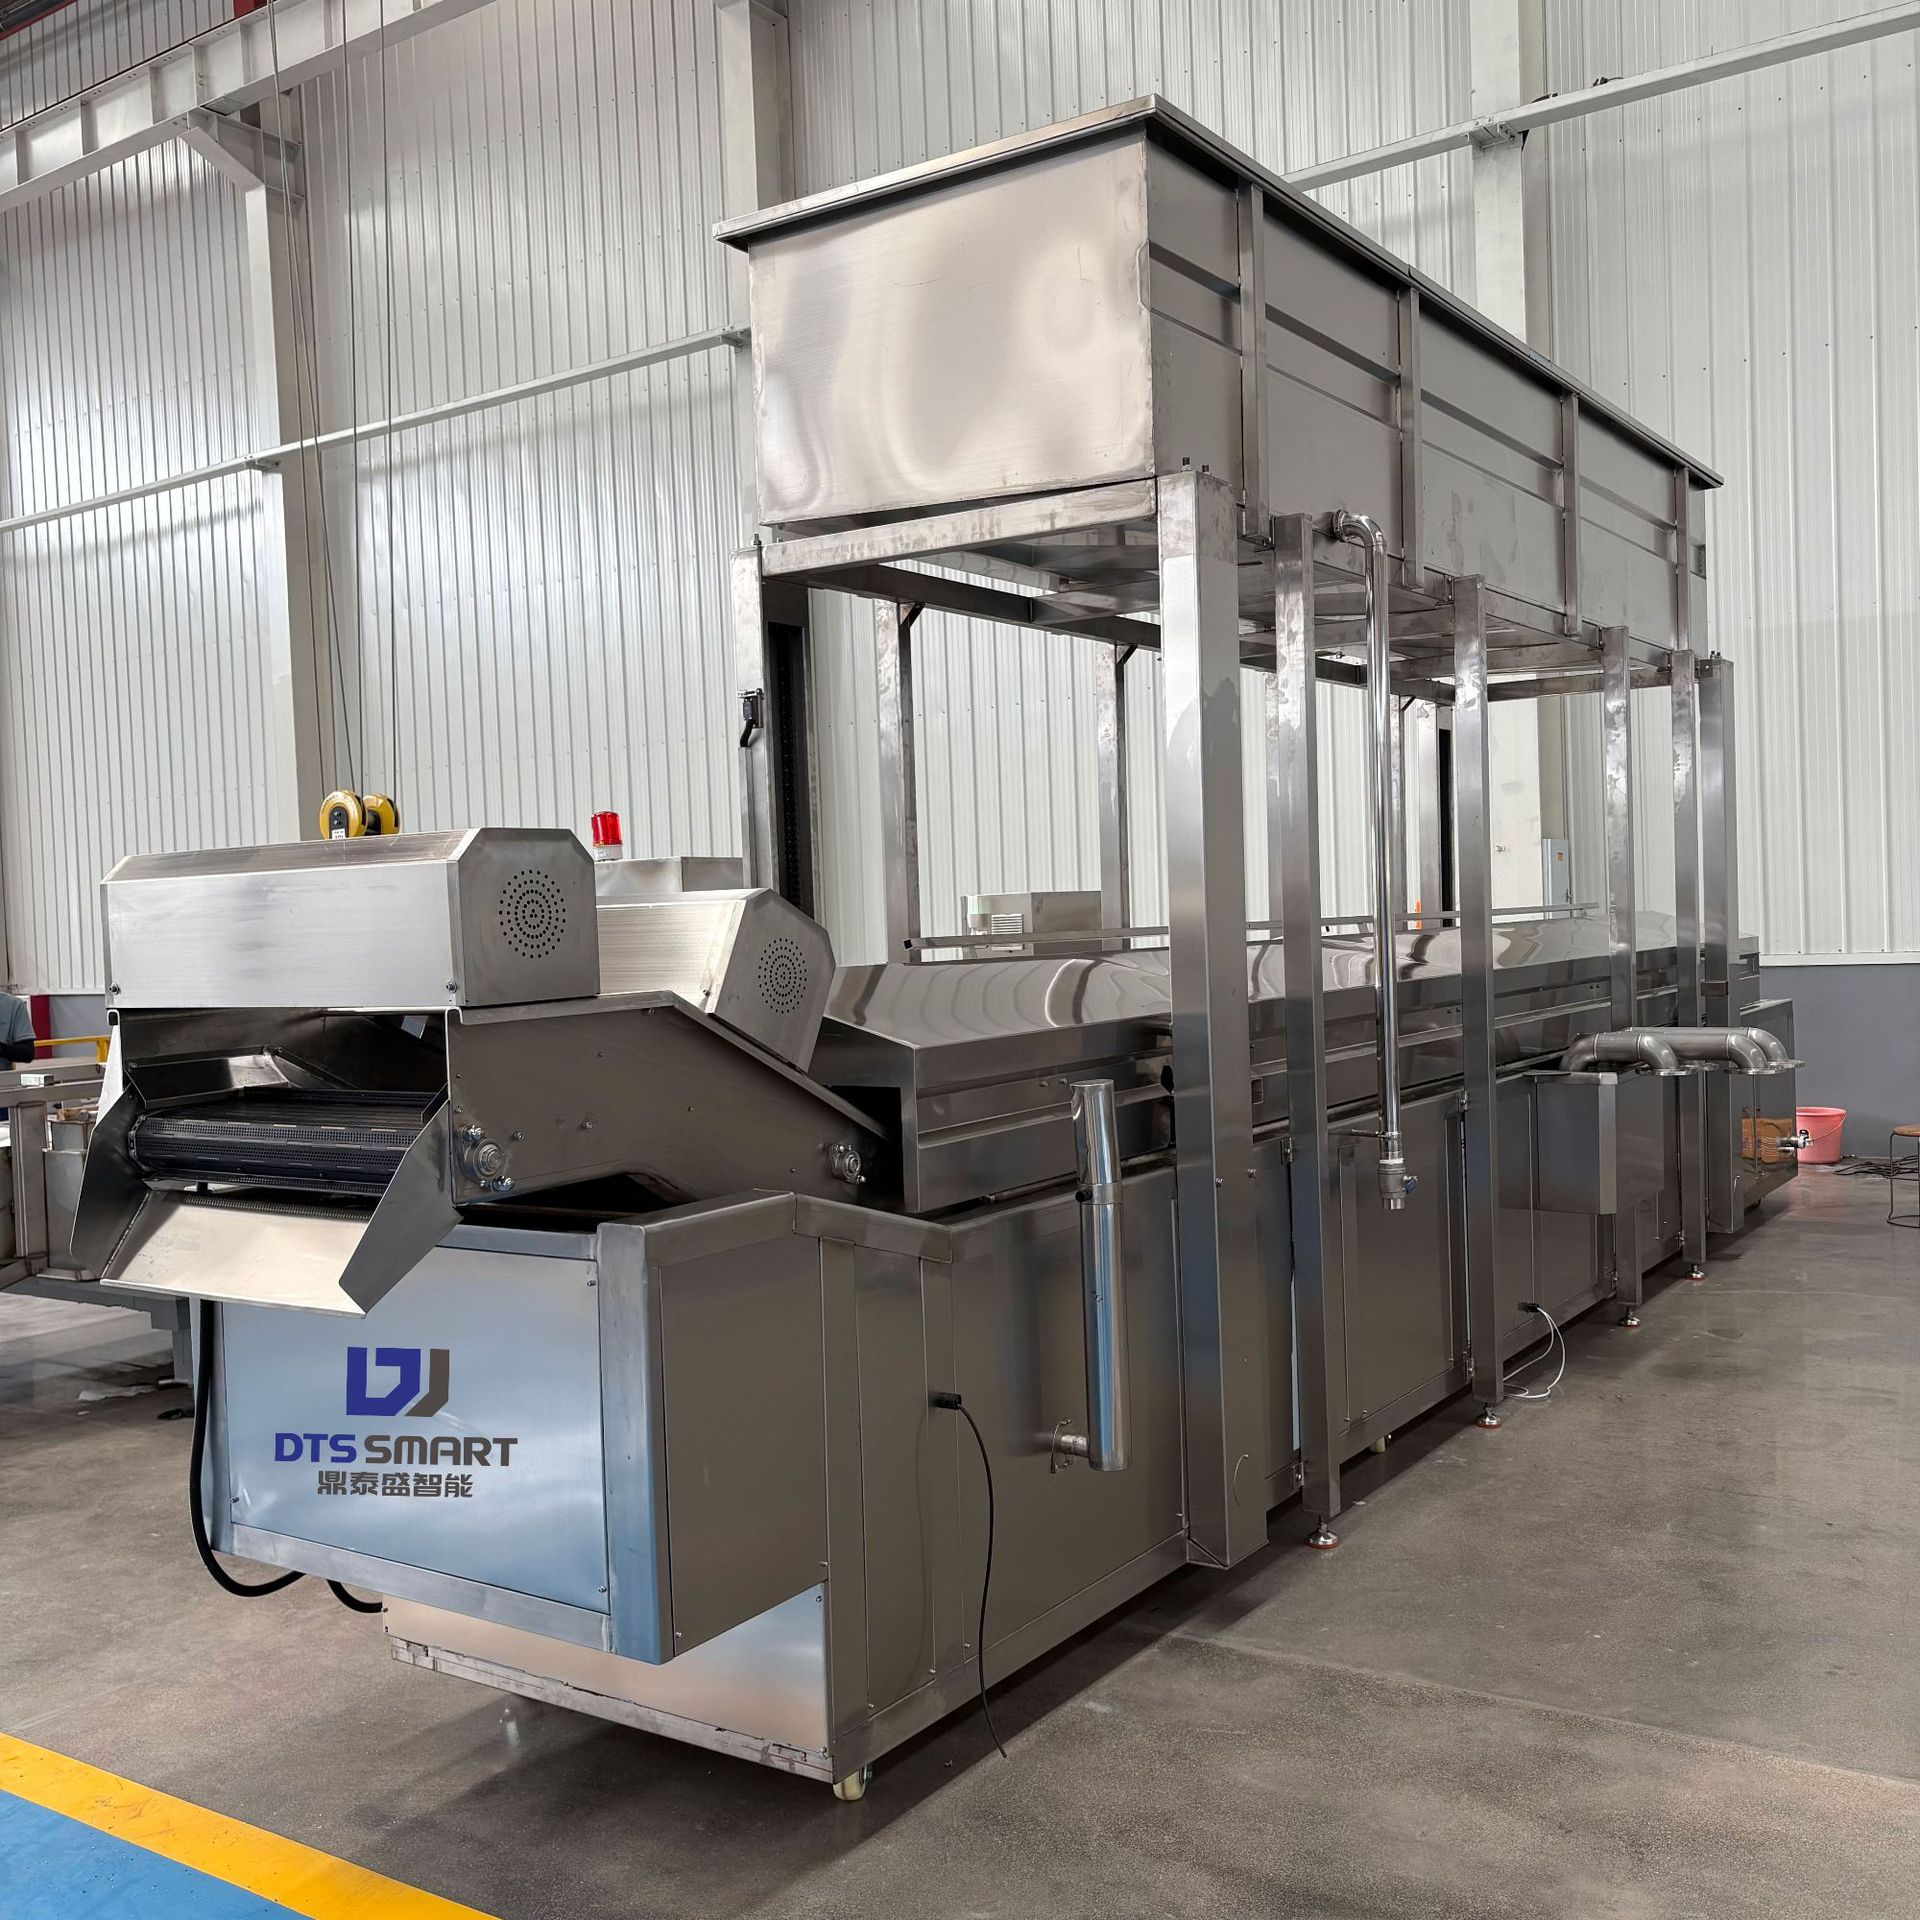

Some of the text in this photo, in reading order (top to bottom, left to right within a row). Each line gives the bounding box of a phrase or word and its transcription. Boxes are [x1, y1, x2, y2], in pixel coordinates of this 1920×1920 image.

[274, 1433, 518, 1467] DTS SMART
[317, 1470, 473, 1498] 鼎泰盛智能
